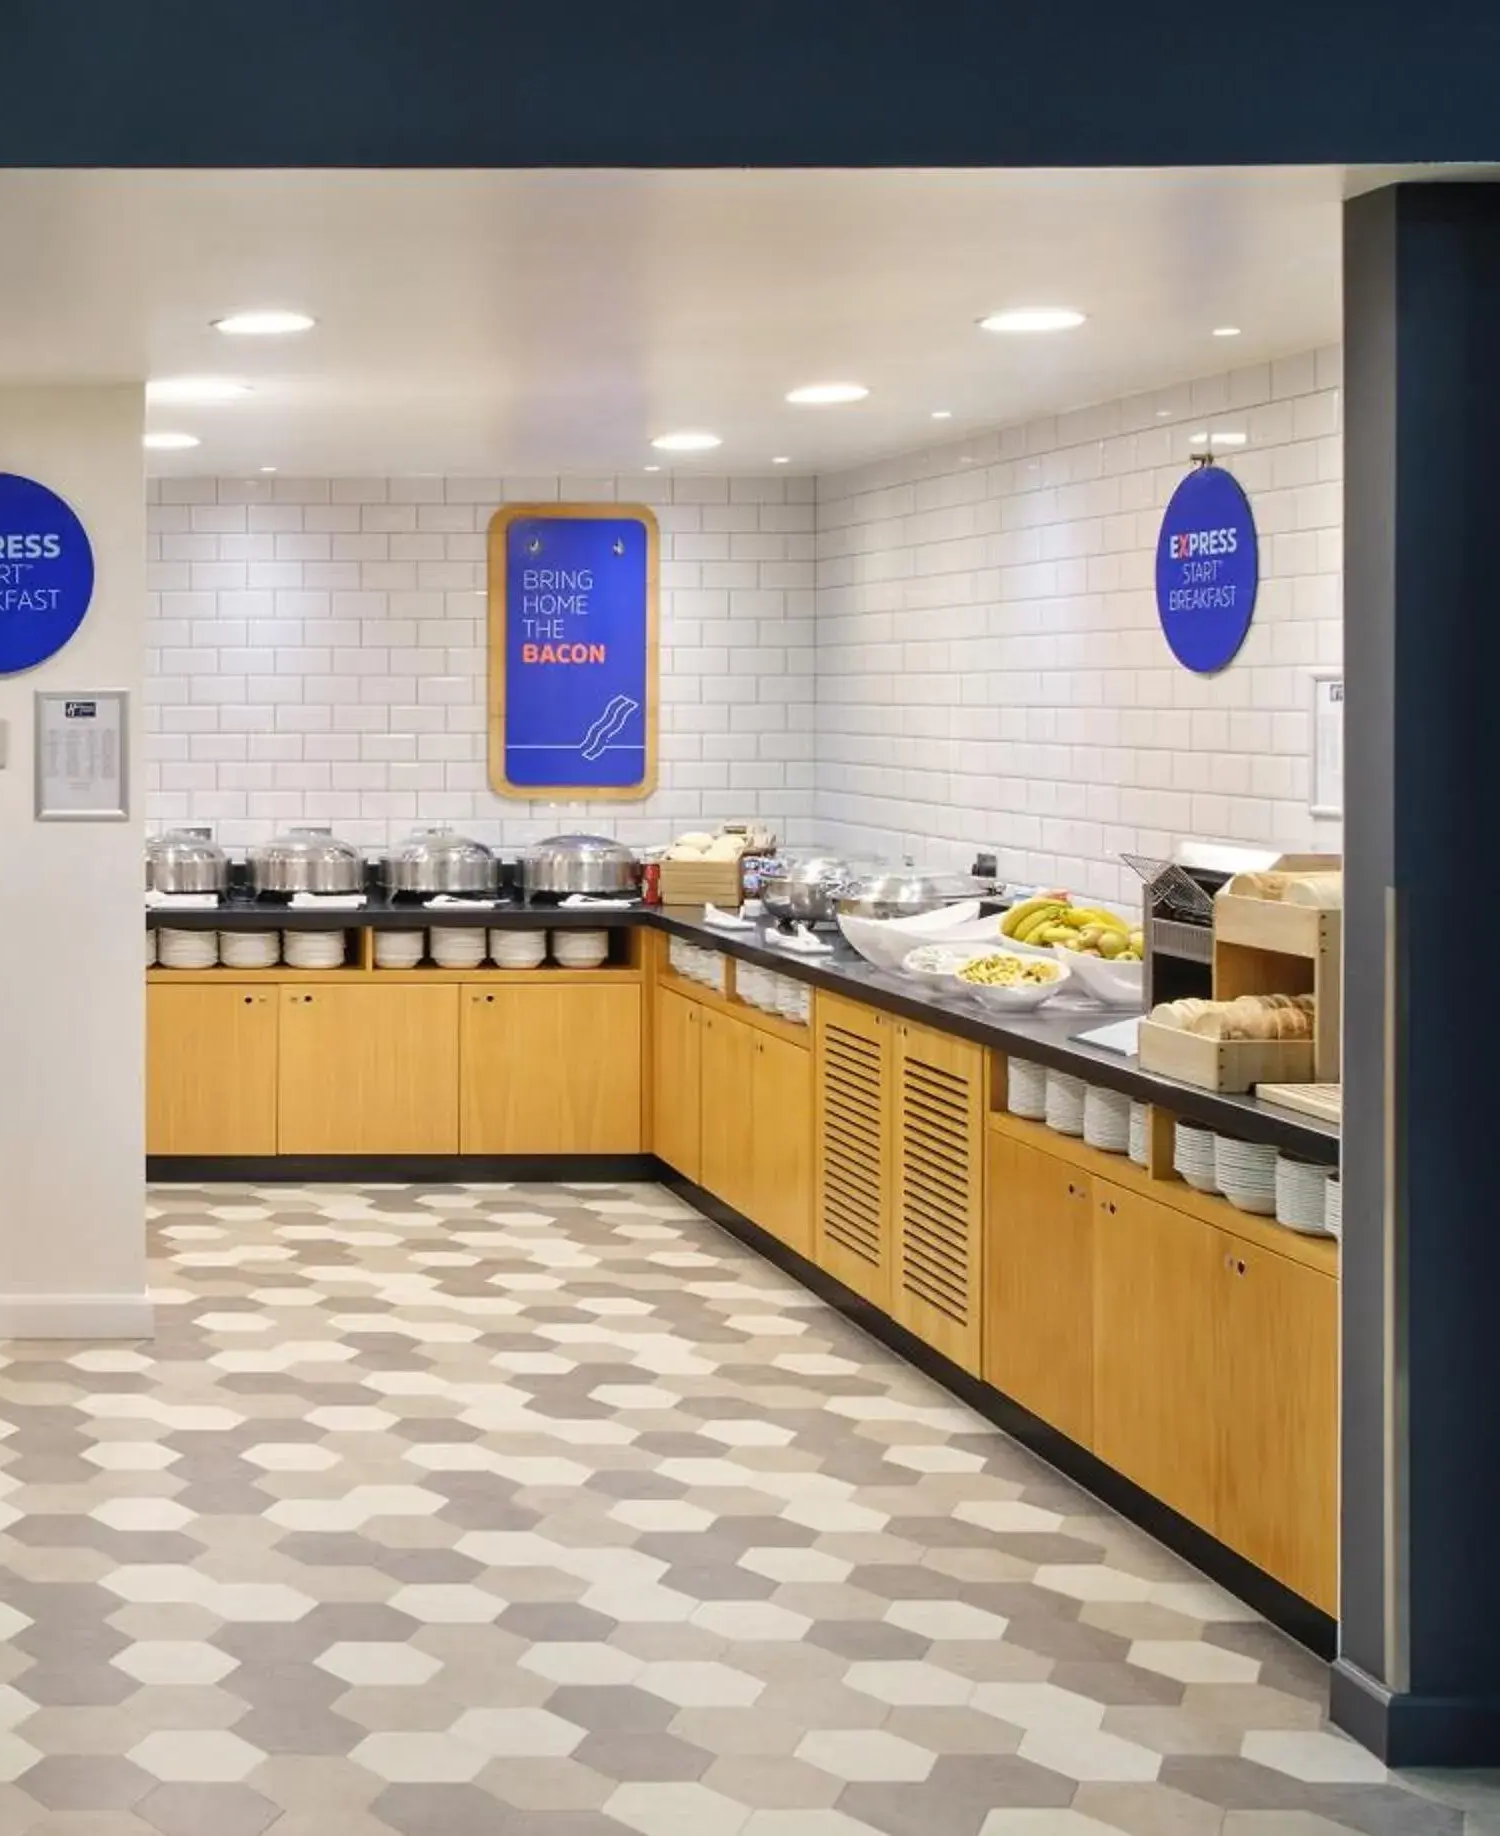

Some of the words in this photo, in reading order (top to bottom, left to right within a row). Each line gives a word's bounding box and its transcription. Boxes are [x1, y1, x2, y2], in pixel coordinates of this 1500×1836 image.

[1169, 527, 1237, 558] EXPRESS
[523, 569, 594, 591] BRING
[523, 594, 589, 615] HOME
[1169, 585, 1237, 611] BREAKFAST
[522, 618, 565, 640] THE
[522, 643, 605, 664] BACON
